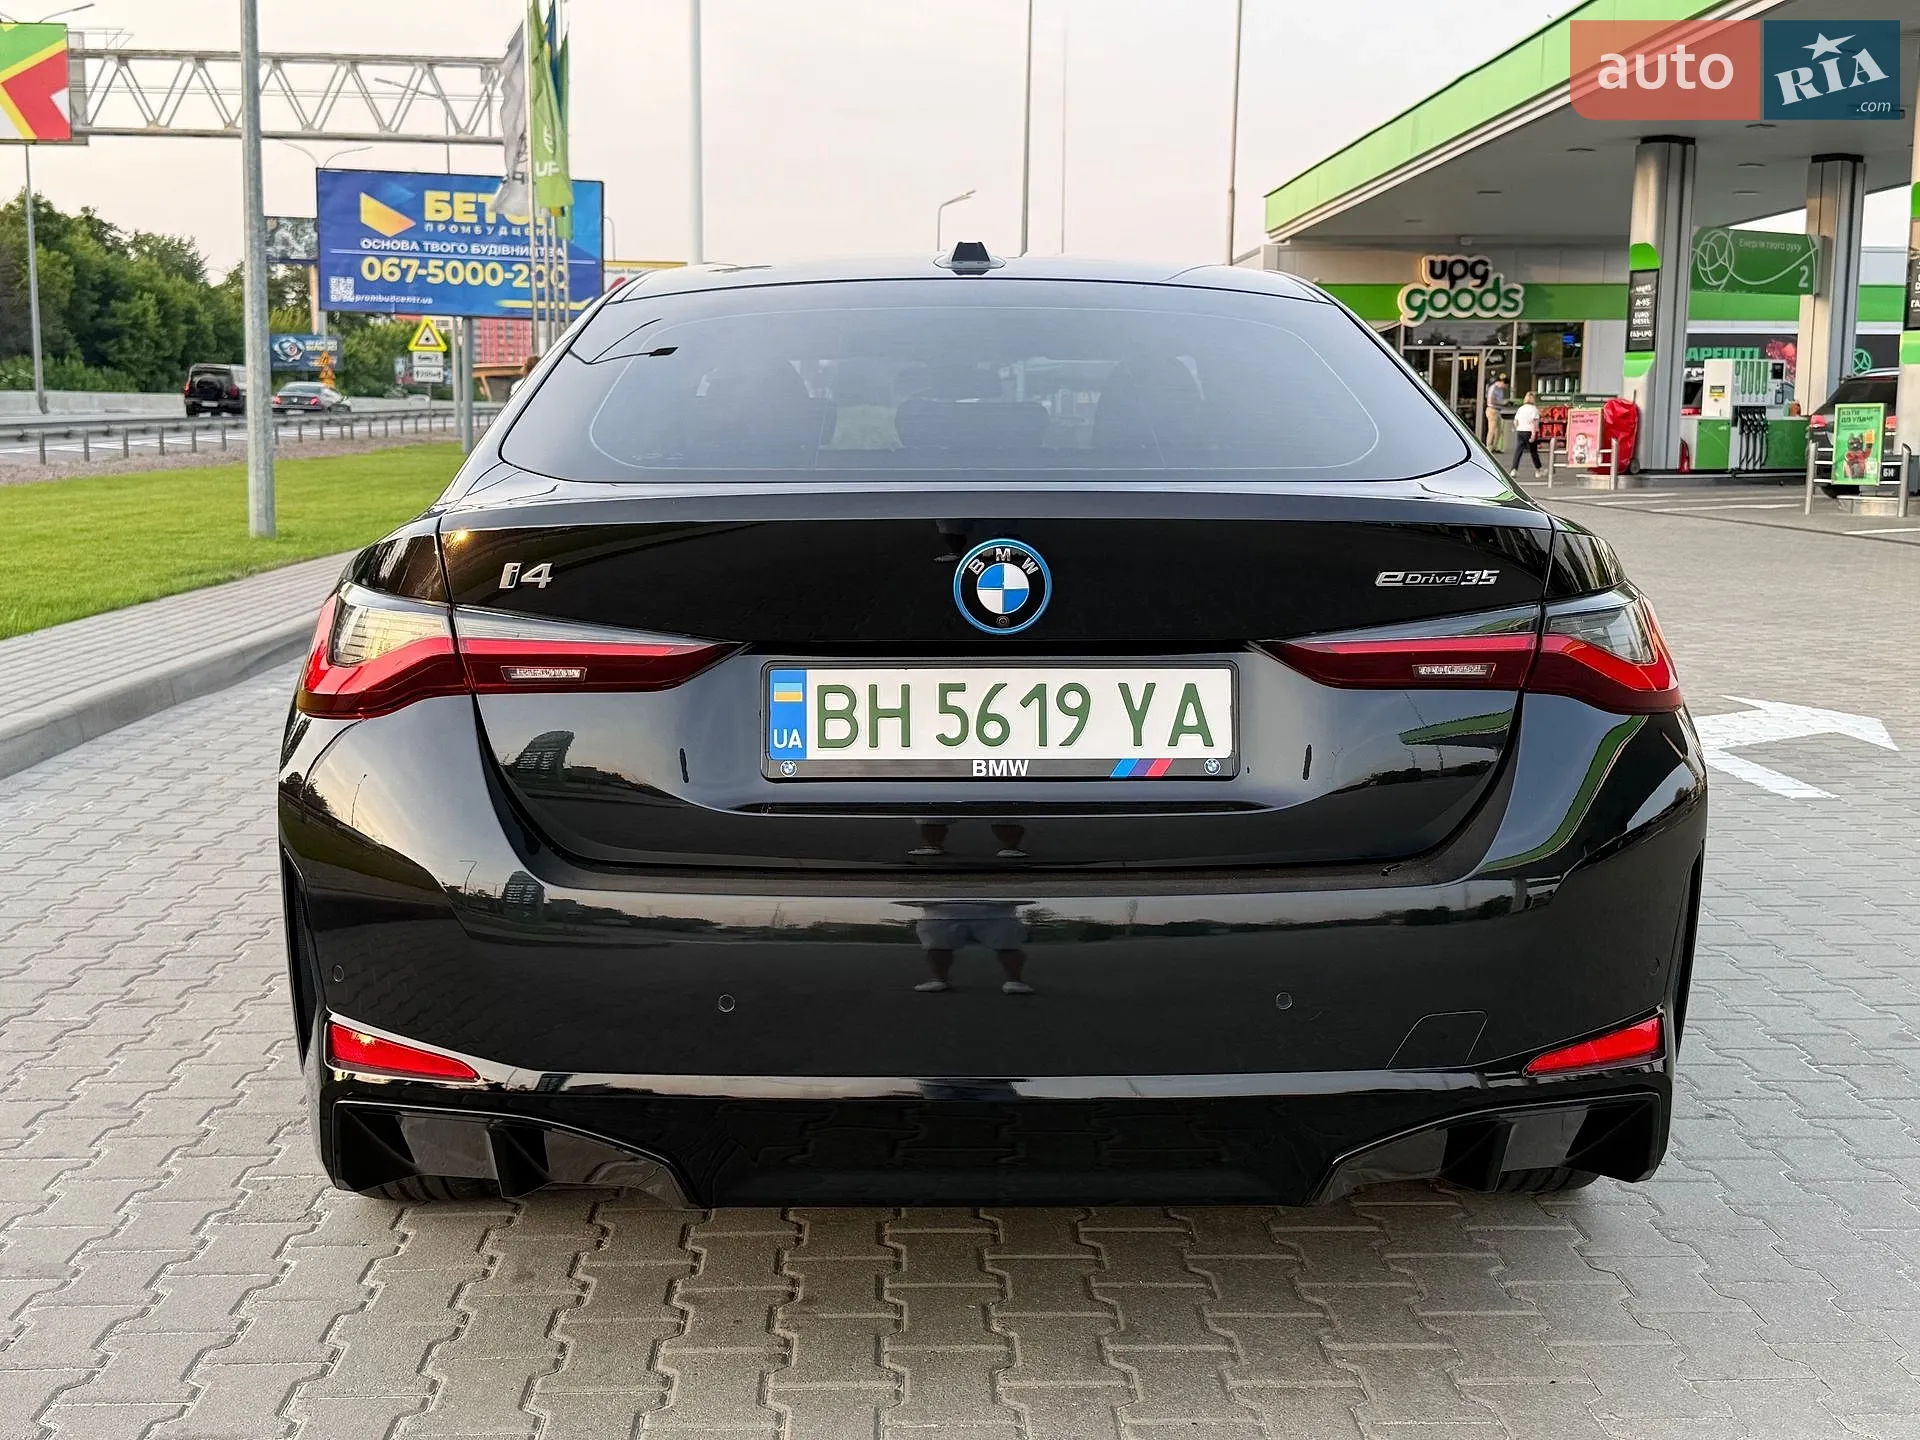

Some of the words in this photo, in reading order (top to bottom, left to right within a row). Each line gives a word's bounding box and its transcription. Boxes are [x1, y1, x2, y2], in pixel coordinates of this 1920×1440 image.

[424, 190, 548, 226] БЕТ
[361, 239, 419, 252] ОСНОВА
[422, 241, 468, 255] ТВОГО
[361, 256, 568, 290] 067-5000-200
[1428, 259, 1490, 290] upg
[1799, 265, 1809, 287] 2
[1405, 276, 1521, 321] goods
[499, 562, 554, 588] i4
[968, 548, 1039, 575] BMW
[816, 683, 912, 749] BH
[935, 682, 1092, 748] 5619
[1117, 682, 1215, 748] YA
[773, 729, 803, 749] UA
[971, 759, 1030, 777] BMW
